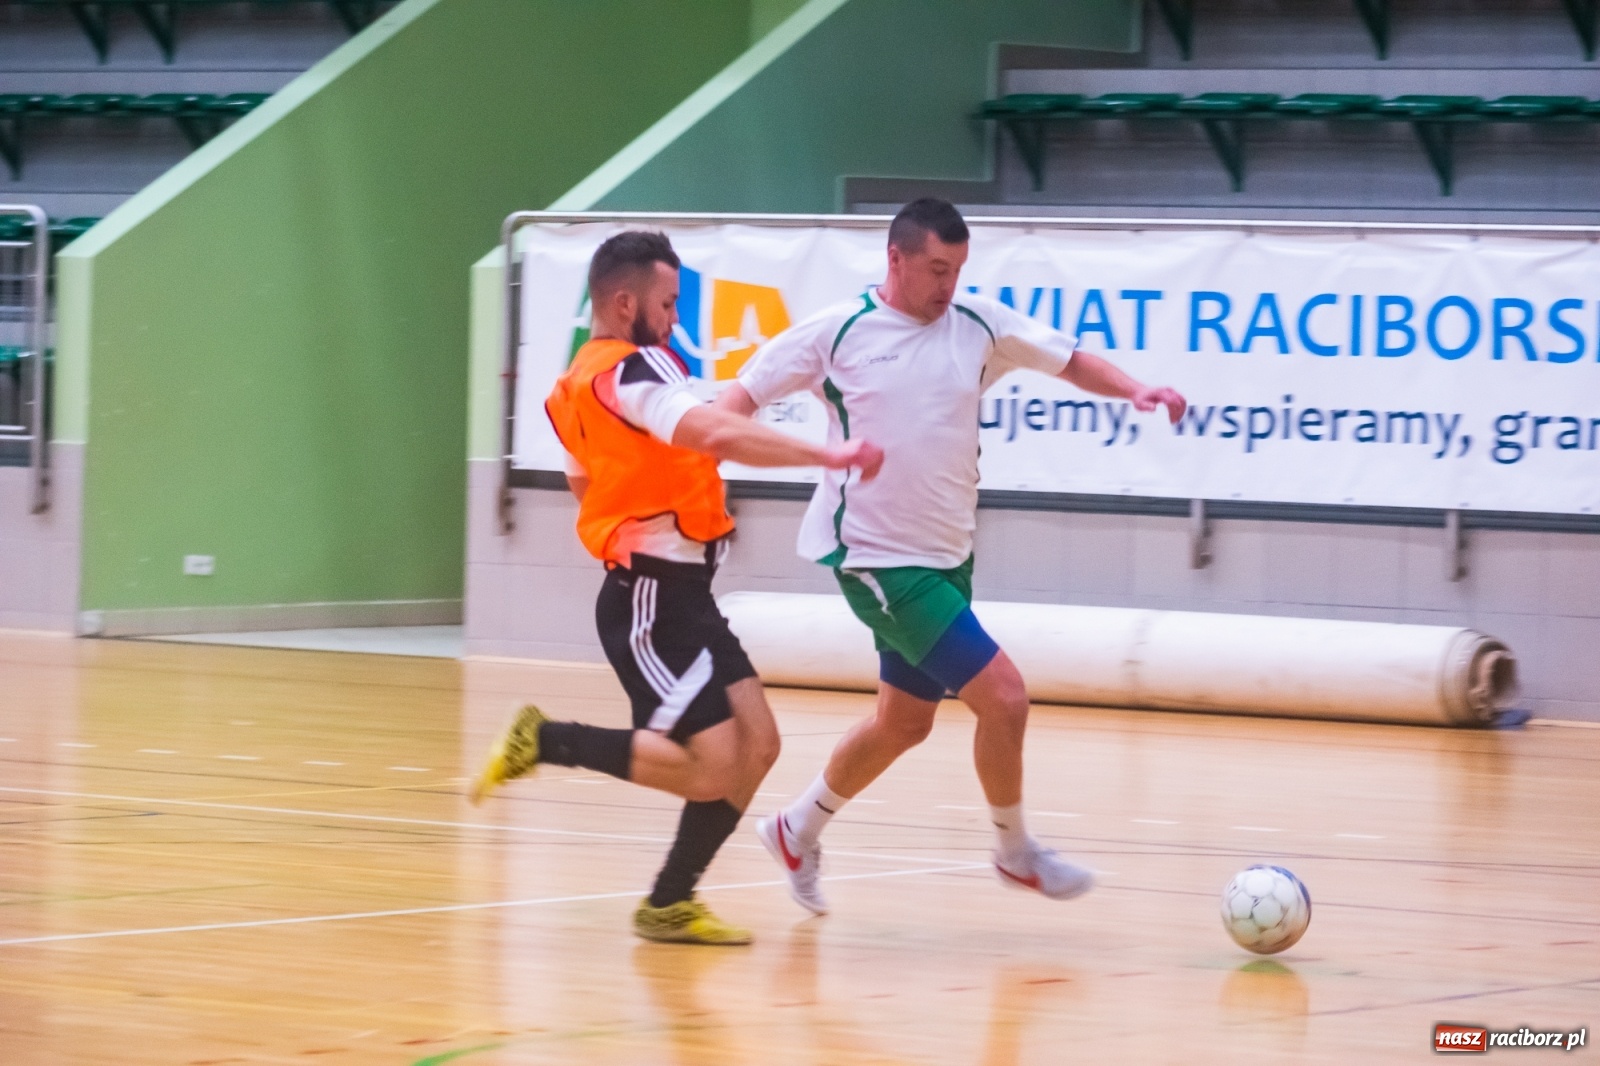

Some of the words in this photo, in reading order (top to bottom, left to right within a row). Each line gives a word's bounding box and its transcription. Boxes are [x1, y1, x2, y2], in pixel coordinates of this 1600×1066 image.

[1188, 290, 1600, 364] RACIBORS
[979, 386, 1141, 447] ujemy,
[1175, 394, 1473, 458] wspieramy,
